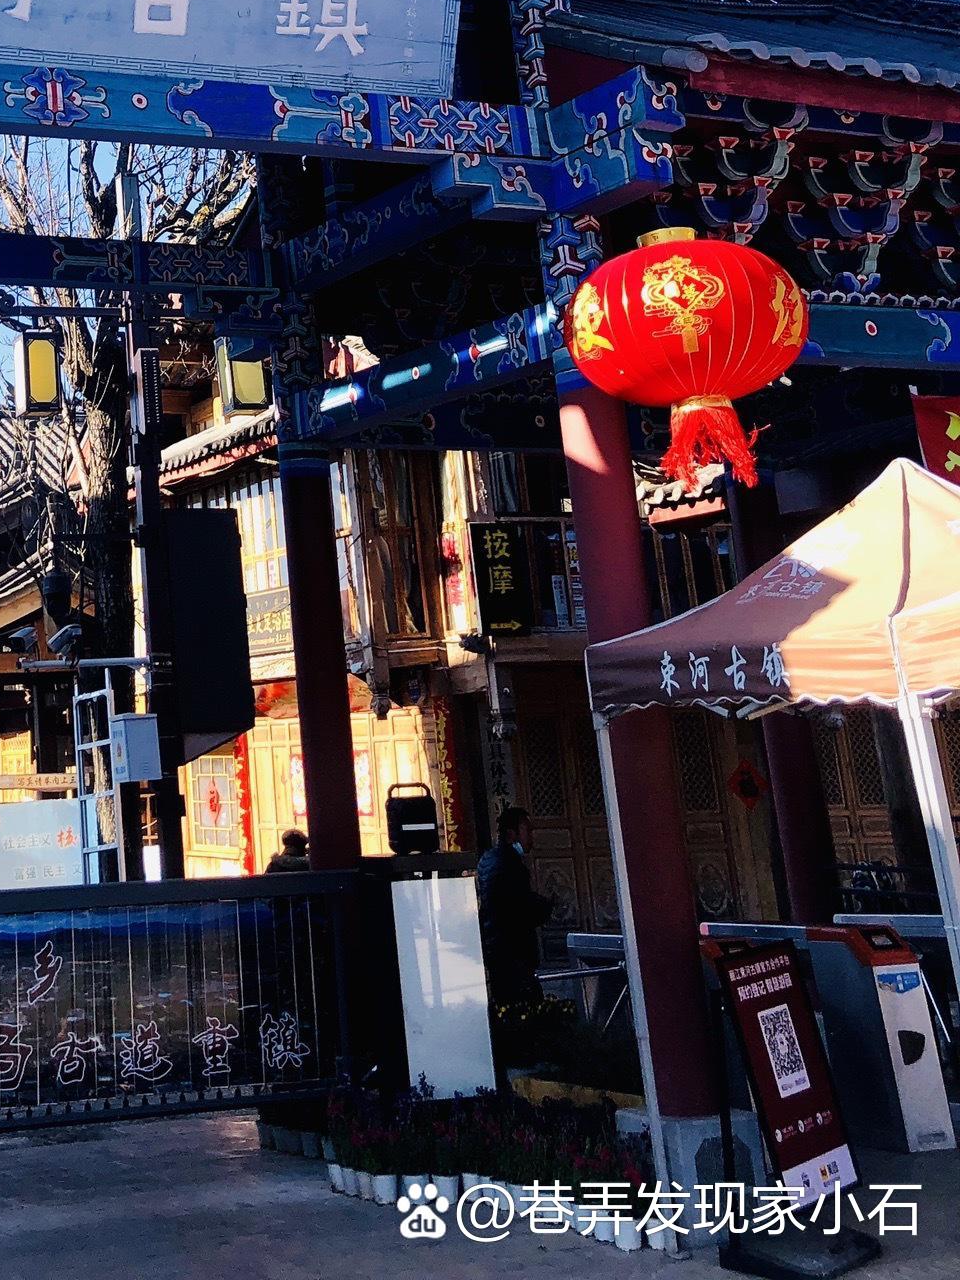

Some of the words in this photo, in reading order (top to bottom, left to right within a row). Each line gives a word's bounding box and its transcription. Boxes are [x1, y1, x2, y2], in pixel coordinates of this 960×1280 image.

[483, 529, 514, 594] 按摩
[660, 642, 790, 697] 束河古镇
